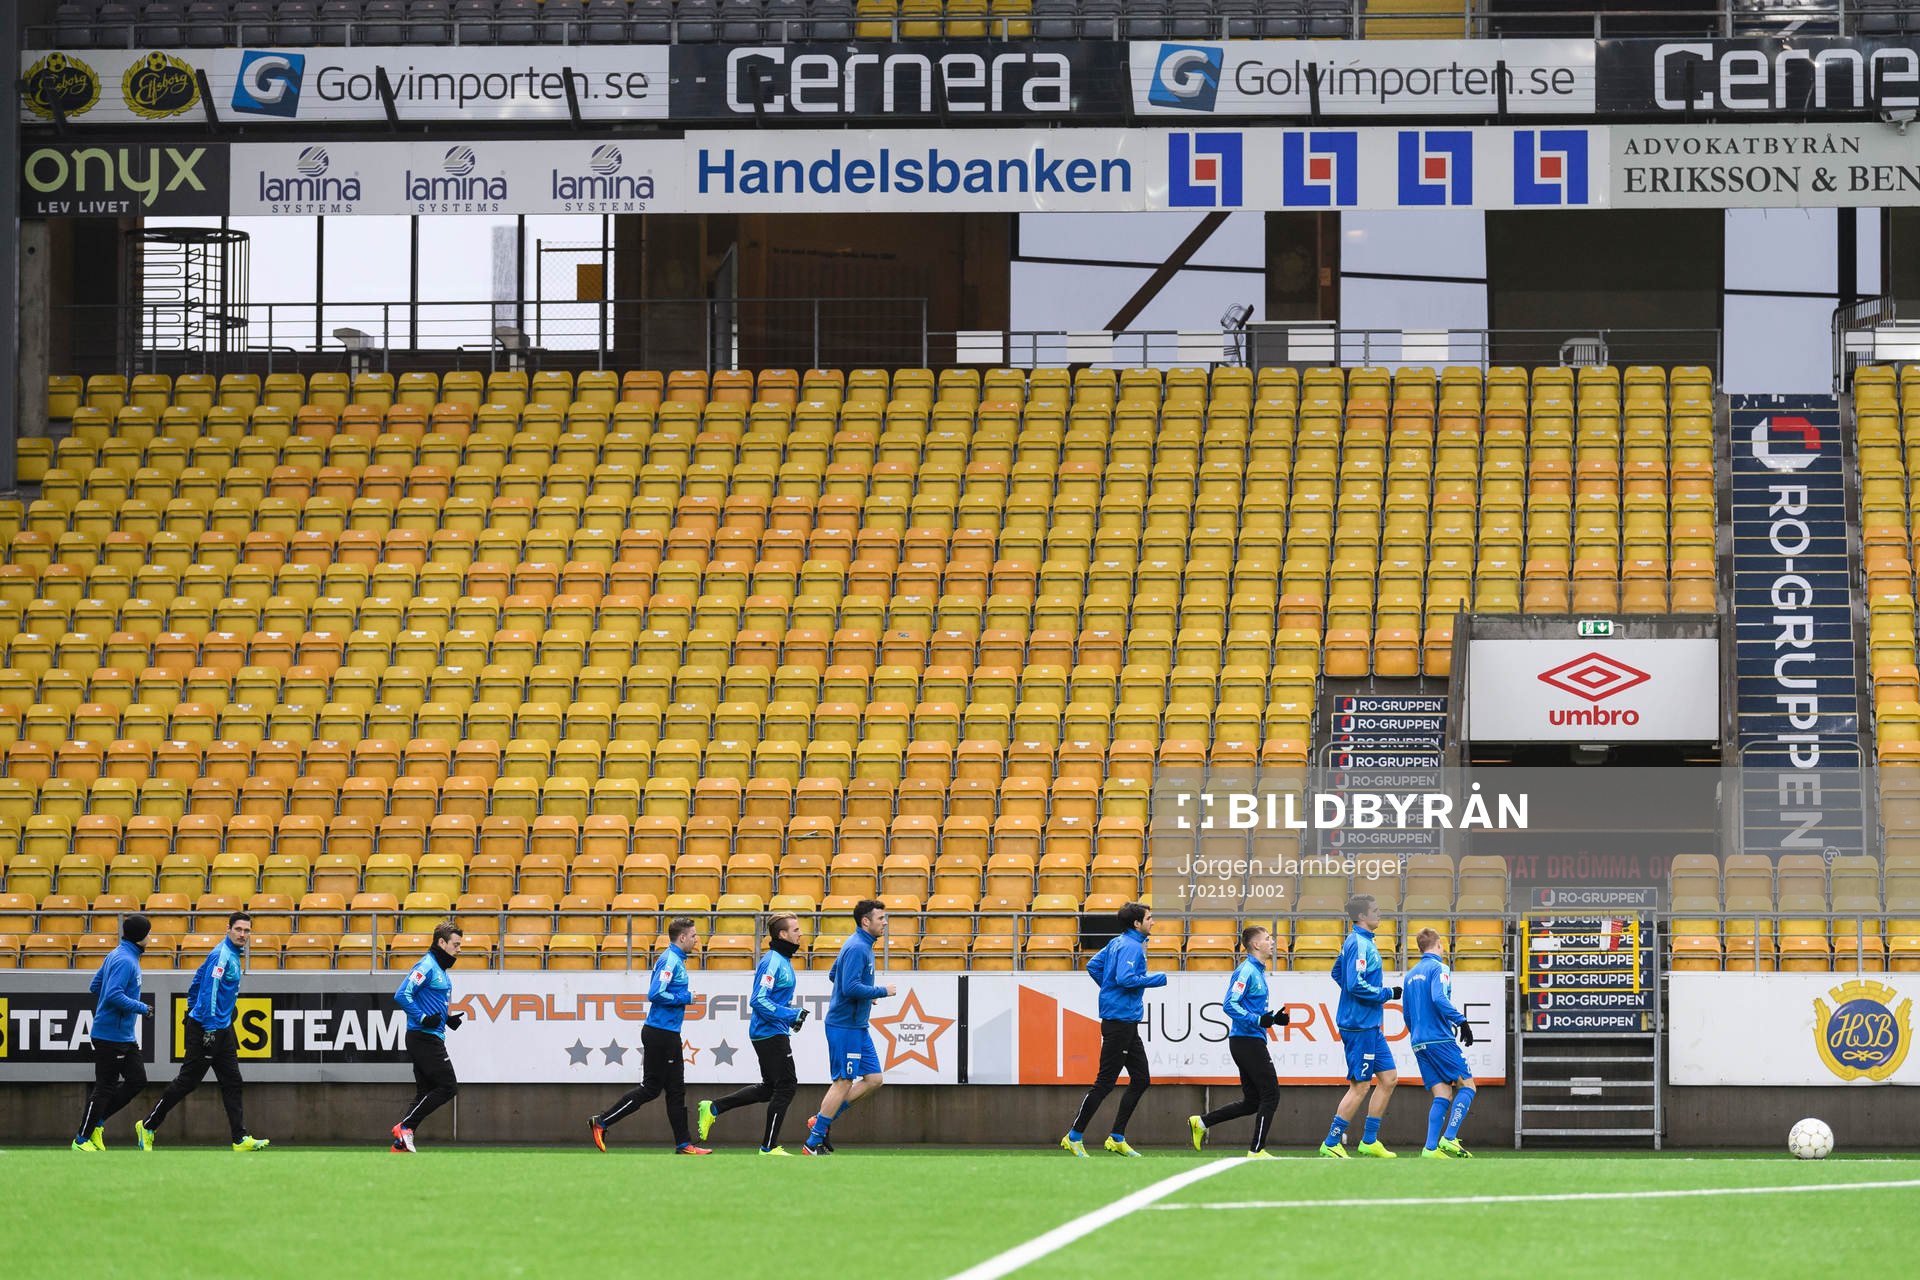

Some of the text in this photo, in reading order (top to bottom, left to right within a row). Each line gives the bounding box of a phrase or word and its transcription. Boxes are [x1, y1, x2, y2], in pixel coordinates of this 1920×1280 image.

[136, 72, 188, 106] Elfsborg
[317, 65, 648, 109] Golvimporten.se
[726, 46, 1071, 113] Cernera
[1235, 59, 1575, 104] Golvimporten.se
[1624, 133, 1861, 156] ADVOKATBYRÅN
[25, 148, 207, 207] onyx
[698, 148, 1131, 195] Handelsbanken
[1624, 166, 1801, 193] ERIKSSON
[1811, 167, 1838, 193] &
[259, 170, 361, 201] lamina
[405, 169, 507, 201] lamina
[552, 168, 655, 200] lamina
[38, 201, 129, 214] LEV LIVET
[272, 204, 353, 213] SYSTEMS
[418, 203, 499, 213] SYSTEMS
[564, 202, 646, 212] SYSTEMS
[1768, 485, 1824, 847] RO-GRUPPEN
[1359, 700, 1441, 712] RO-GRUPPEN
[1549, 705, 1640, 726] umbro
[1357, 719, 1440, 730] RO-GRUPPEN
[1357, 737, 1439, 748] ROGRUPPEN
[1356, 757, 1439, 768] RO-GRUPPEN
[1352, 775, 1435, 786] RO-GRUPPEN
[1347, 833, 1432, 844] RO-GRUPPEN
[1548, 851, 1641, 880] DRÖMMA
[1559, 892, 1645, 903] RO-GRUPPEN
[1556, 994, 1645, 1005] RO-GRUPPEN
[10, 1009, 142, 1050] TEA
[274, 1010, 408, 1050] TEAM
[1553, 1016, 1634, 1027] RO-GRUPPEN
[1831, 1013, 1893, 1048] HSB
[846, 1061, 853, 1074] 6
[1361, 1062, 1369, 1076] 2
